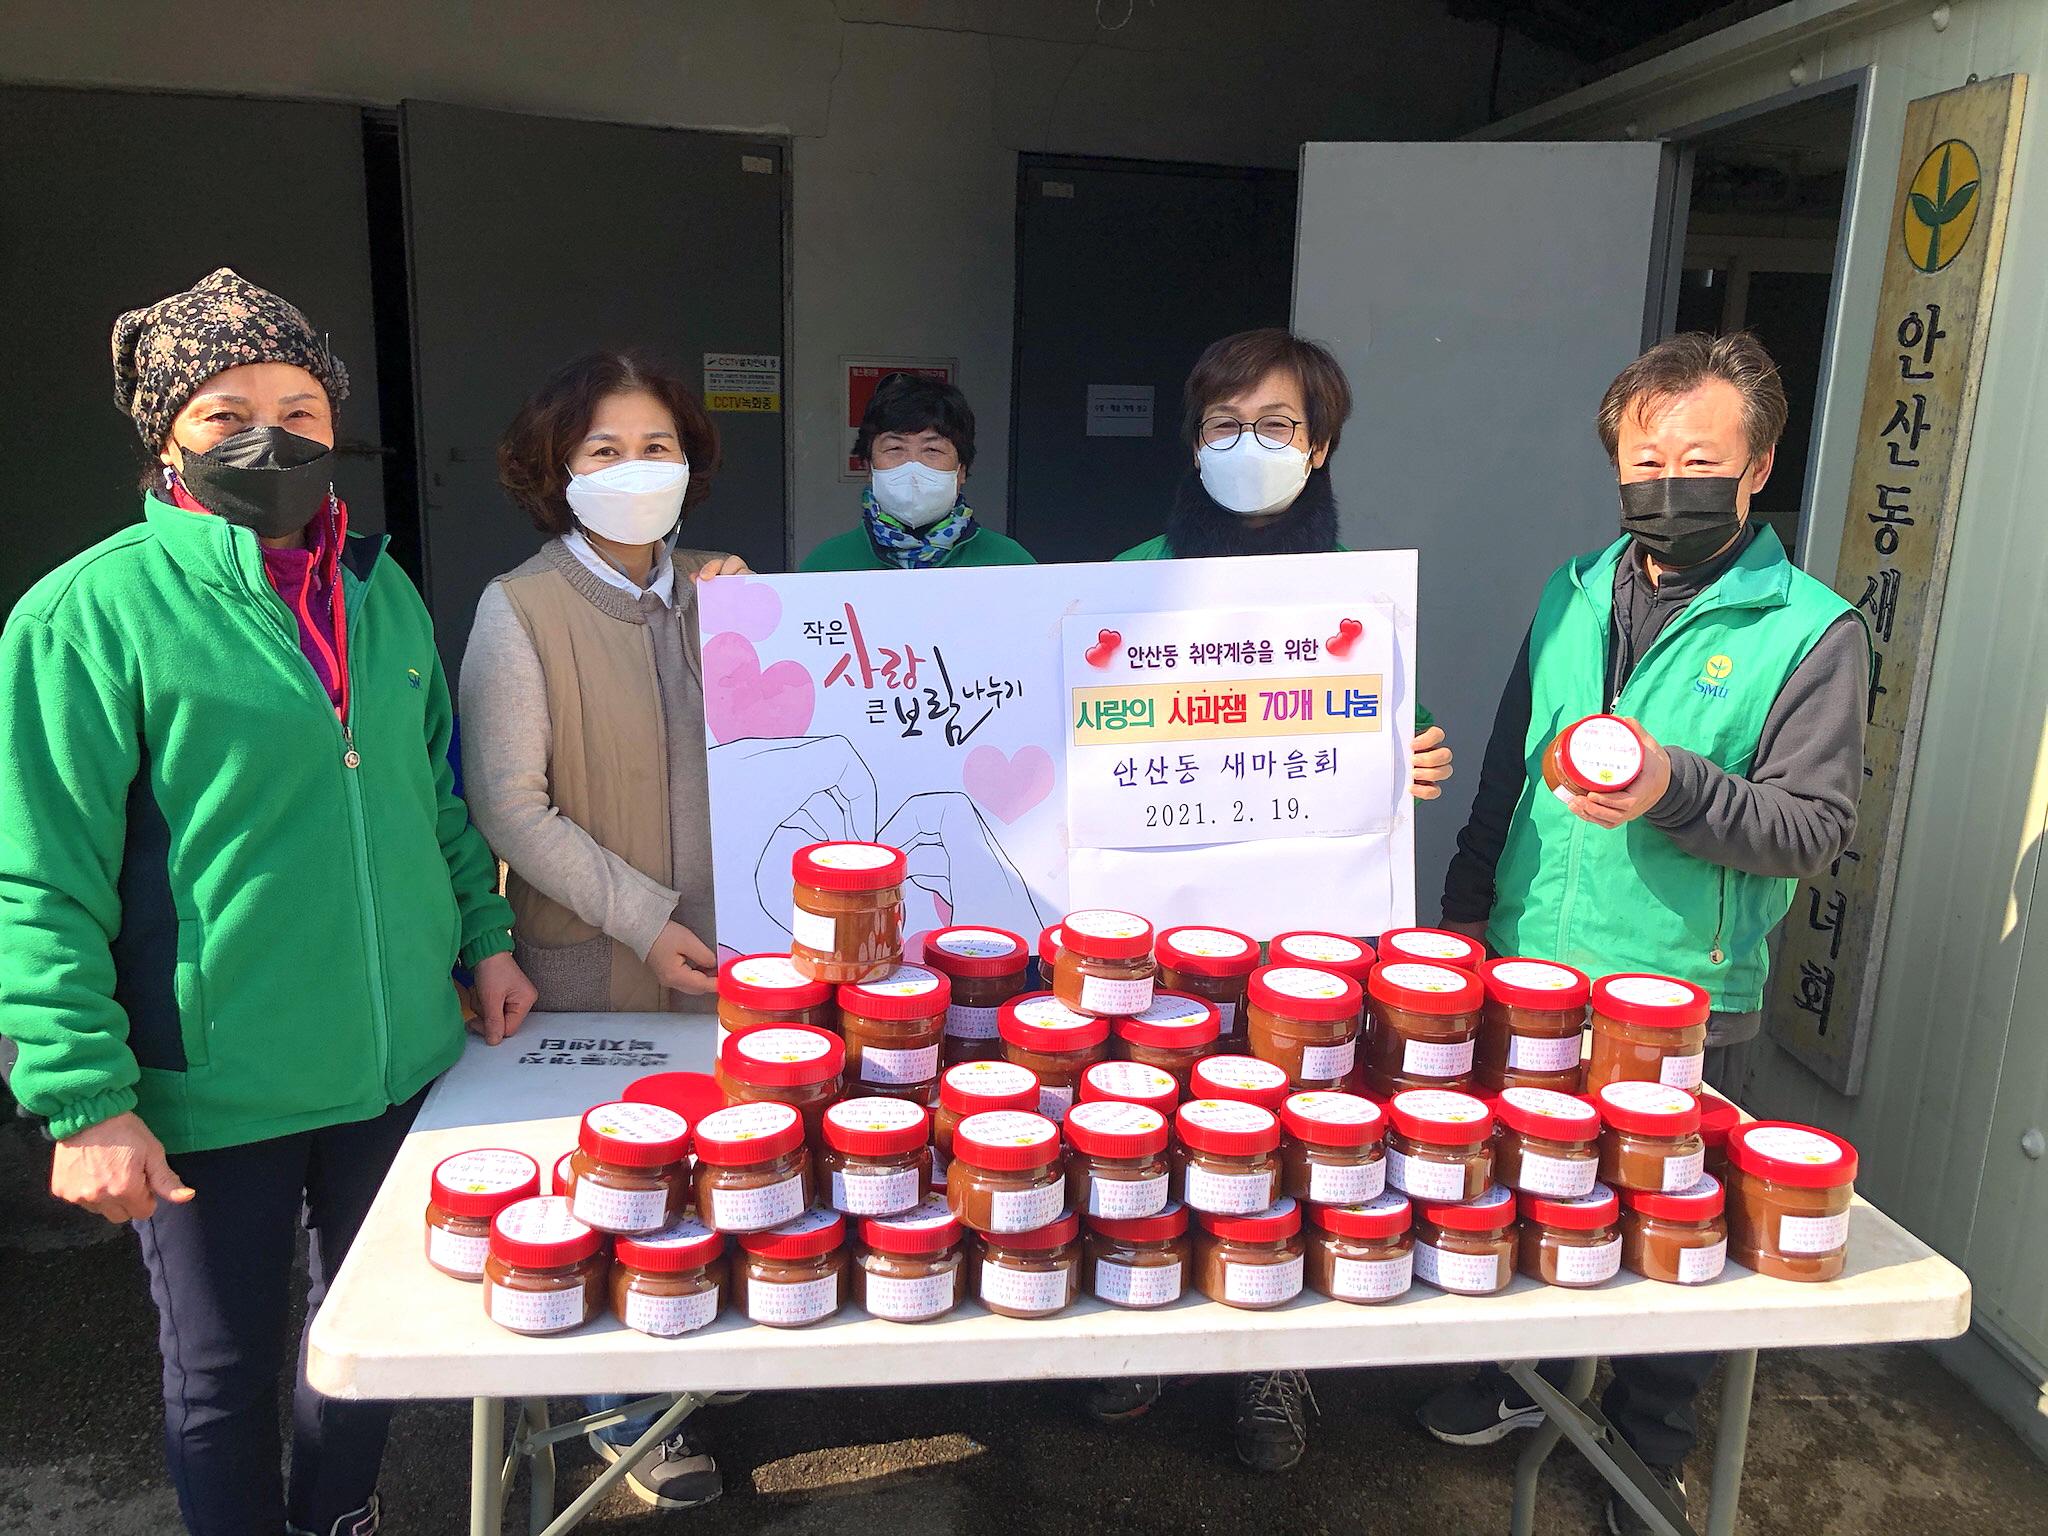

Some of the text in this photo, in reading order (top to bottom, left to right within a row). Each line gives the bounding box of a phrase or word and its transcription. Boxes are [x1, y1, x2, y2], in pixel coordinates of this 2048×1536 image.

[803, 602, 926, 690] 작은 사랑
[1127, 637, 1319, 669] 안산동 취약계층을 위한
[866, 699, 887, 724] 큰
[963, 676, 1022, 708] 나누기
[1076, 689, 1378, 730] 사랑의 사과잼 70개 나눔
[1113, 748, 1338, 787] 안산동 새마을회
[1146, 797, 1309, 828] 2021. 2. 19.
